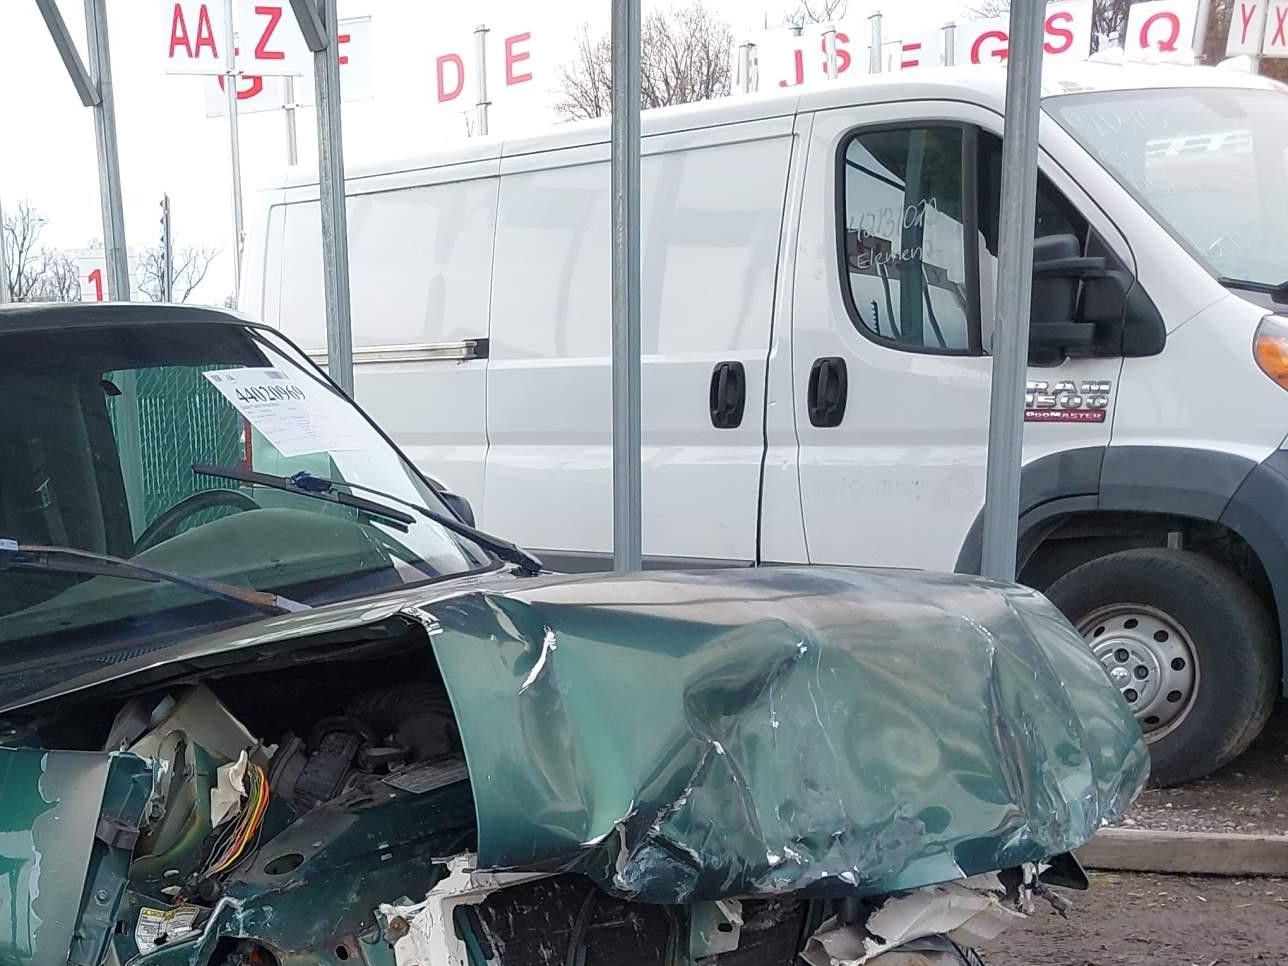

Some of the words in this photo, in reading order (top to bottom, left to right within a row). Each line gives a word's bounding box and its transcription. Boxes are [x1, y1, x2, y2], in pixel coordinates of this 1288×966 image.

[168, 3, 219, 58] AA
[254, 6, 285, 60] Z
[1043, 11, 1074, 55] S
[1139, 11, 1178, 53] Q
[1241, 3, 1256, 45] Y
[1271, 6, 1288, 46] X
[437, 53, 464, 103] D
[505, 32, 532, 86] E
[234, 384, 306, 403] 44020969
[1025, 381, 1111, 395] RAM
